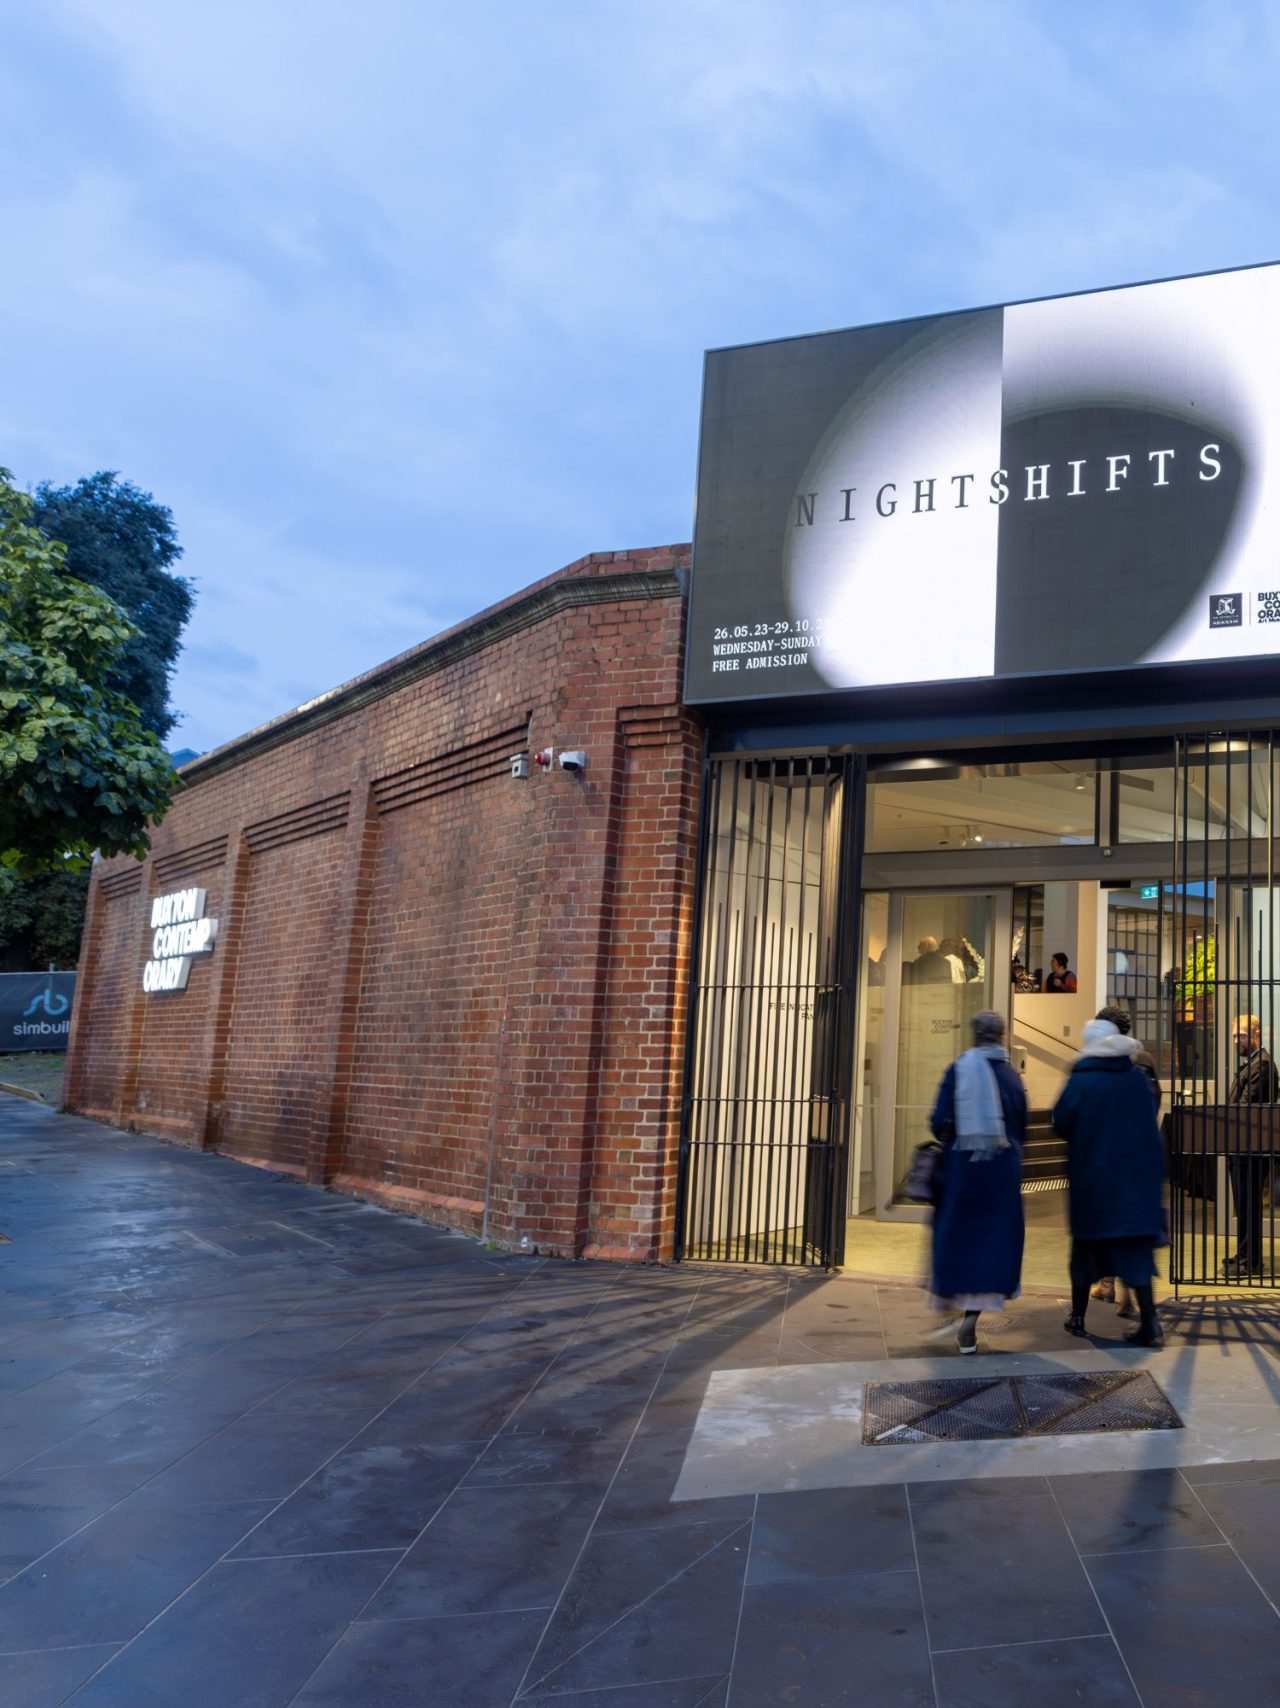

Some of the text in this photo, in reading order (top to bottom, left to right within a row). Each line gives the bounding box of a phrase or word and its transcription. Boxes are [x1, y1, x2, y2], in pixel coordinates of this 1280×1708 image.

[794, 443, 1222, 527] NIGHTSHIFTS
[714, 618, 829, 640] 26.05.23-29.10.2
[713, 635, 823, 656] WEDNESDAY-SUNDAY
[712, 653, 809, 673] FREE ADMISSION
[151, 888, 204, 928] BUXTON
[153, 918, 215, 958] CONTEMP
[143, 957, 188, 992] ORARY
[13, 1021, 70, 1036] simbuil
